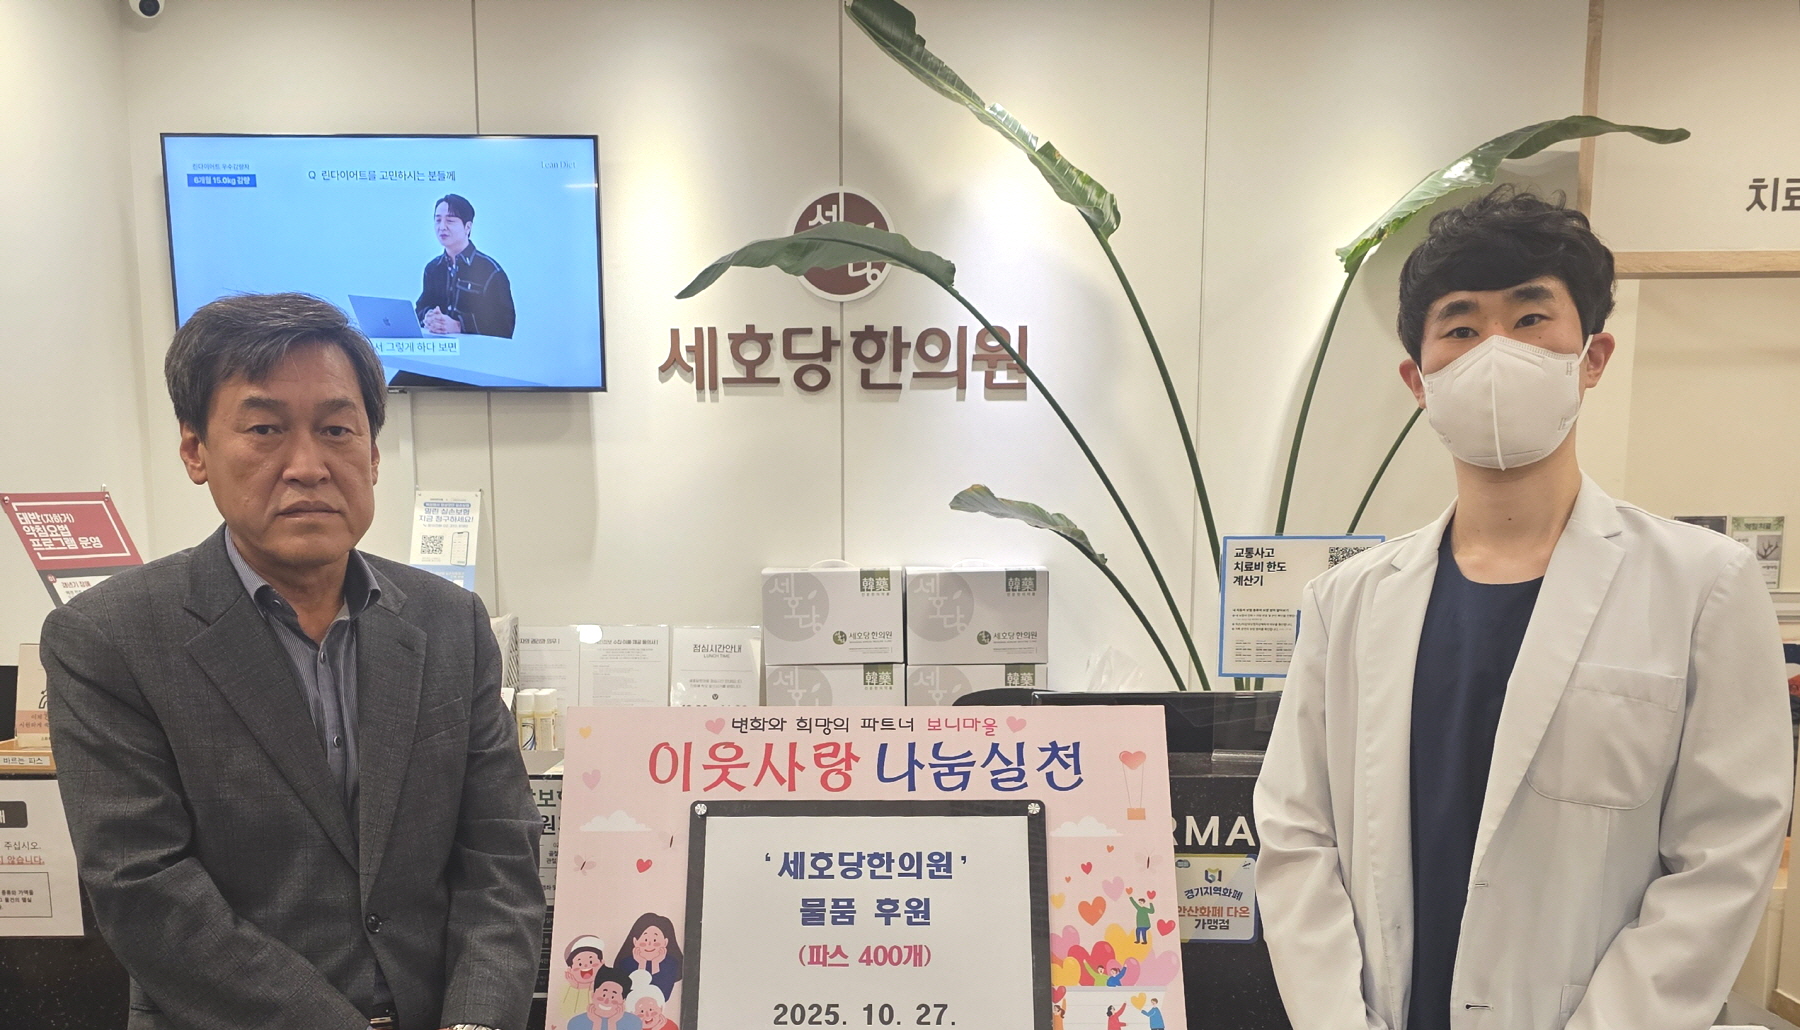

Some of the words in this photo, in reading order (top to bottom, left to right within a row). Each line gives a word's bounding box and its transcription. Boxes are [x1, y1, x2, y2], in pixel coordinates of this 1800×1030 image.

[308, 170, 317, 180] Q
[321, 170, 376, 181] 린다이어트를
[379, 170, 425, 181] 고민하시는
[428, 170, 456, 181] 분들께
[386, 341, 414, 352] 그렇게
[417, 341, 434, 352] 하다
[438, 342, 457, 352] 보면
[22, 524, 72, 537] 약침요법
[29, 537, 78, 550] 프로그램
[78, 536, 103, 548] 운영
[1233, 547, 1274, 558] 교통사고
[1233, 561, 1264, 572] 치료비
[1266, 561, 1287, 572] 한도
[1232, 575, 1263, 586] 계산기
[693, 643, 742, 653] 점심시간안내
[731, 717, 787, 735] 변화와
[795, 717, 849, 735] 희망의
[860, 717, 915, 733] 파트너
[926, 717, 998, 736] 보니마을
[3, 757, 25, 765] 바르는
[648, 741, 861, 793] 이웃사랑
[876, 740, 1084, 793] 나눔실천
[4, 841, 41, 850] 주십시오.
[7, 855, 45, 864] 않습니다.
[1184, 886, 1243, 901] 경기지역화폐
[800, 898, 856, 926] 물품
[874, 897, 931, 926] 후원
[1178, 905, 1223, 917] 안산화폐
[1226, 905, 1250, 918] 다온
[1194, 918, 1230, 930] 가맹점
[798, 945, 849, 967] (파스
[858, 945, 931, 967] 400개)
[772, 1003, 847, 1026] 2025.
[862, 1003, 901, 1026] 10.
[915, 1003, 956, 1026] 27.
